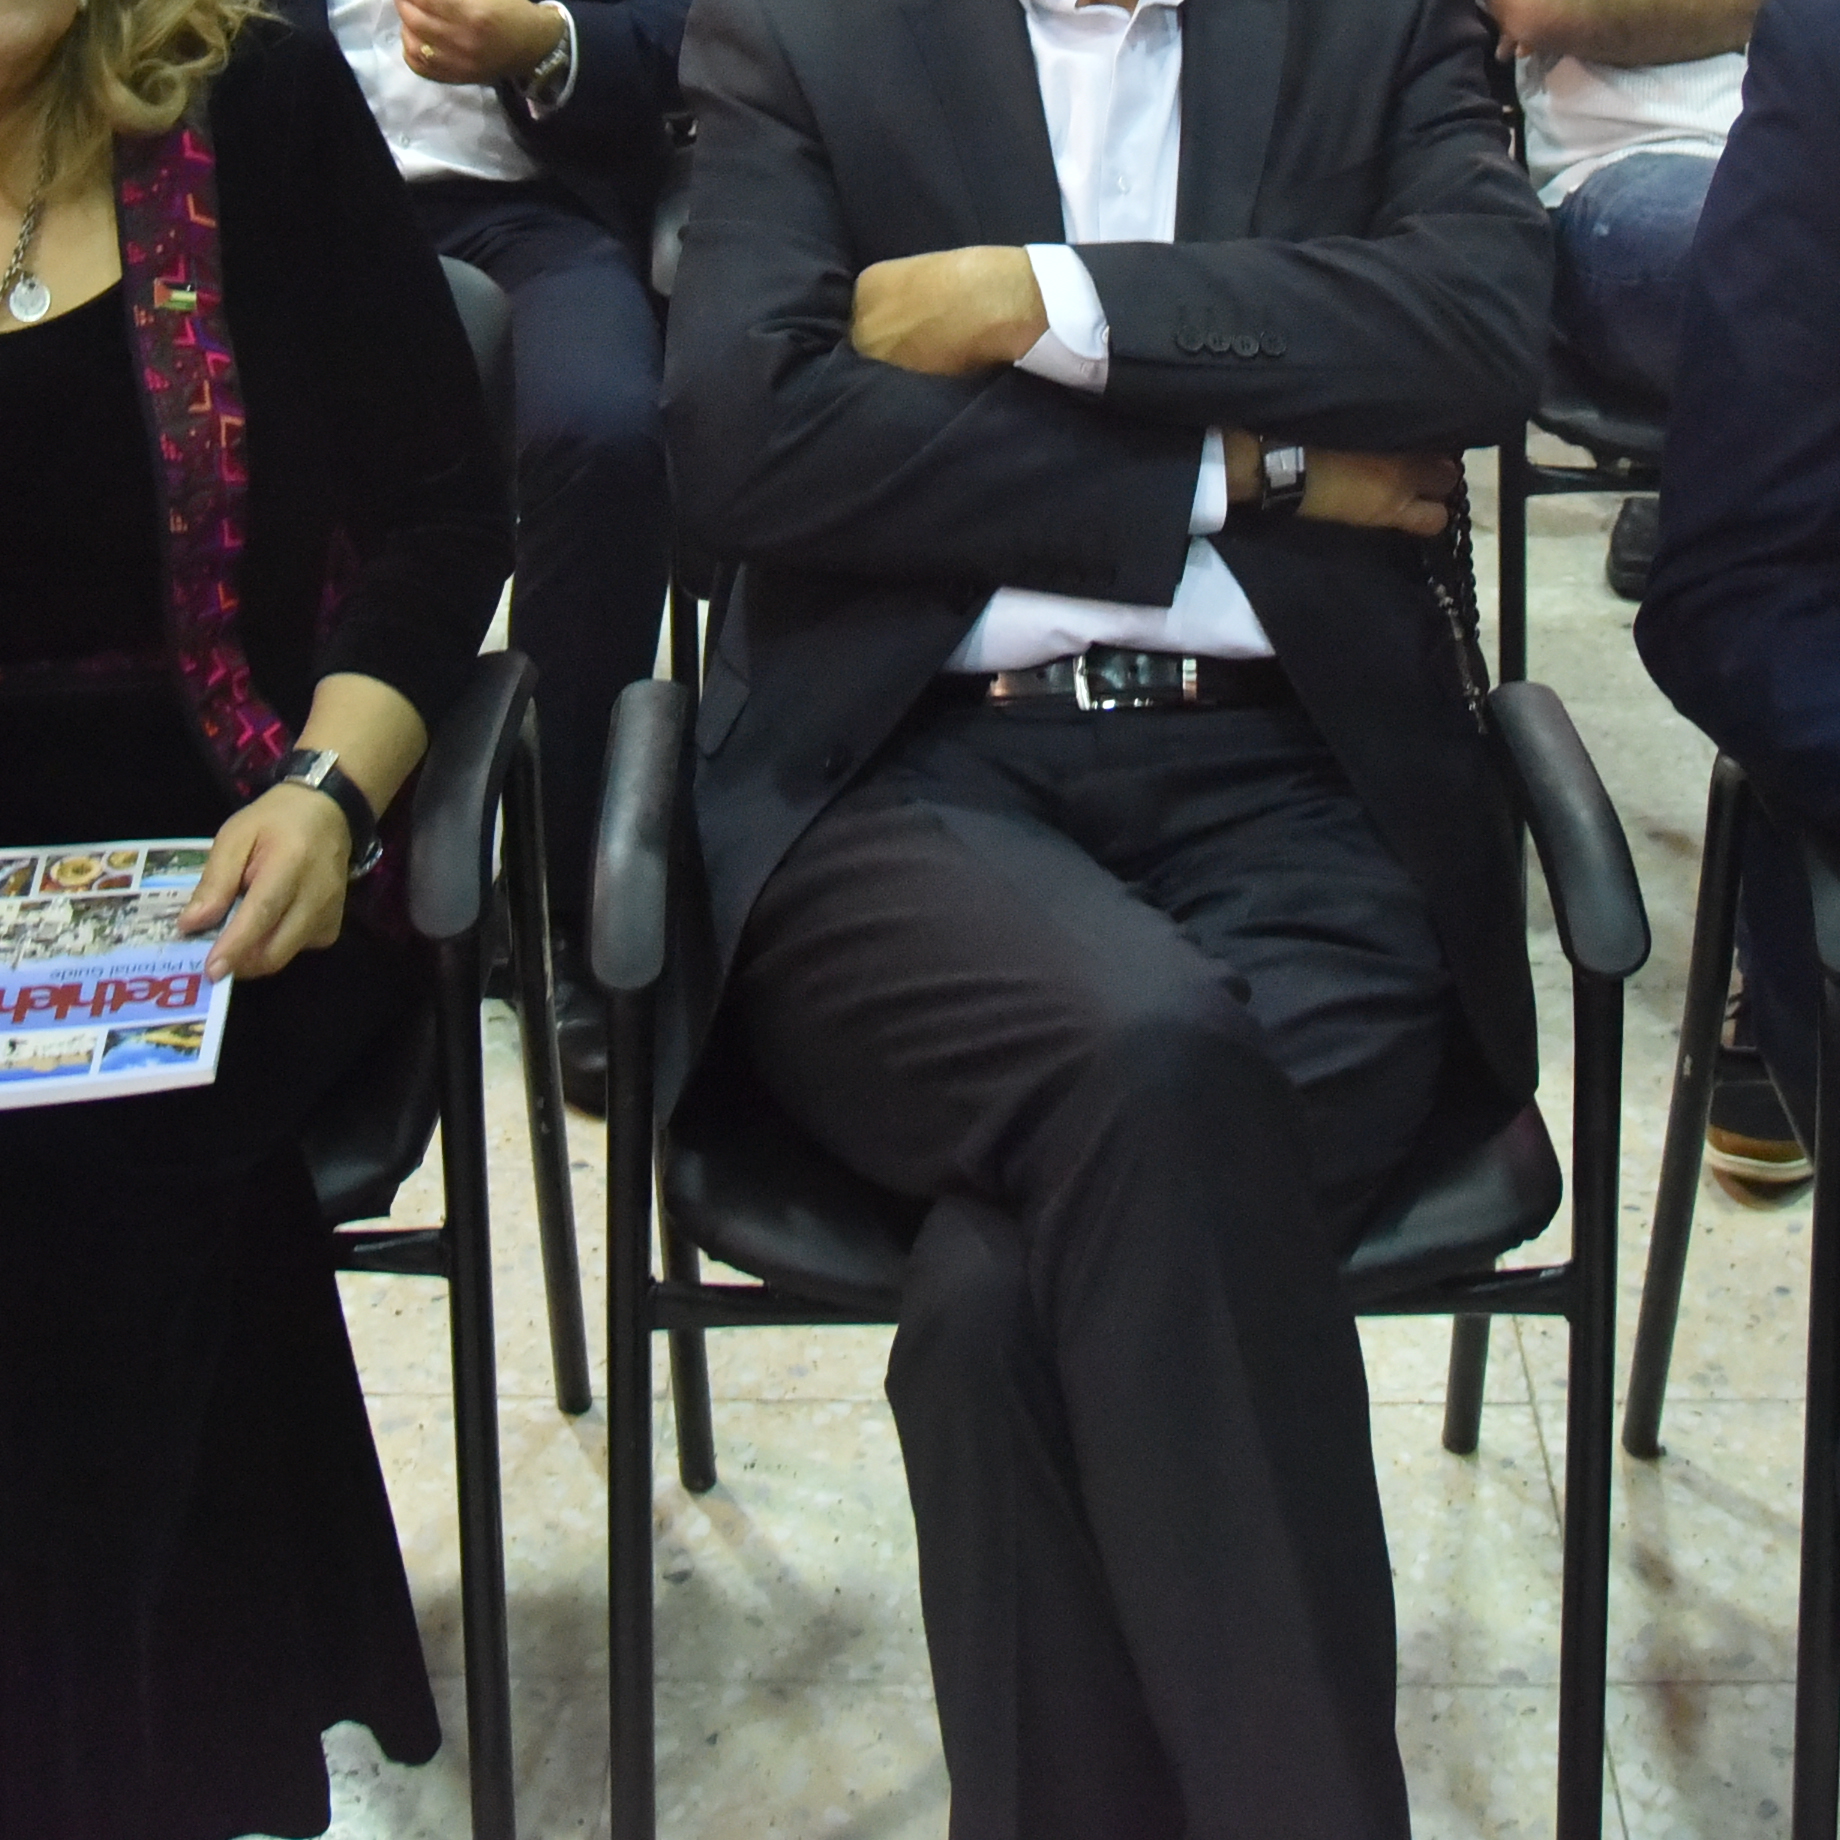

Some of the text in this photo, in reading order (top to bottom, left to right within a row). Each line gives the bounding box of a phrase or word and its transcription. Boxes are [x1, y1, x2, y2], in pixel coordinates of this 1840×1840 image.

[49, 960, 203, 981] A Pictorial Guide
